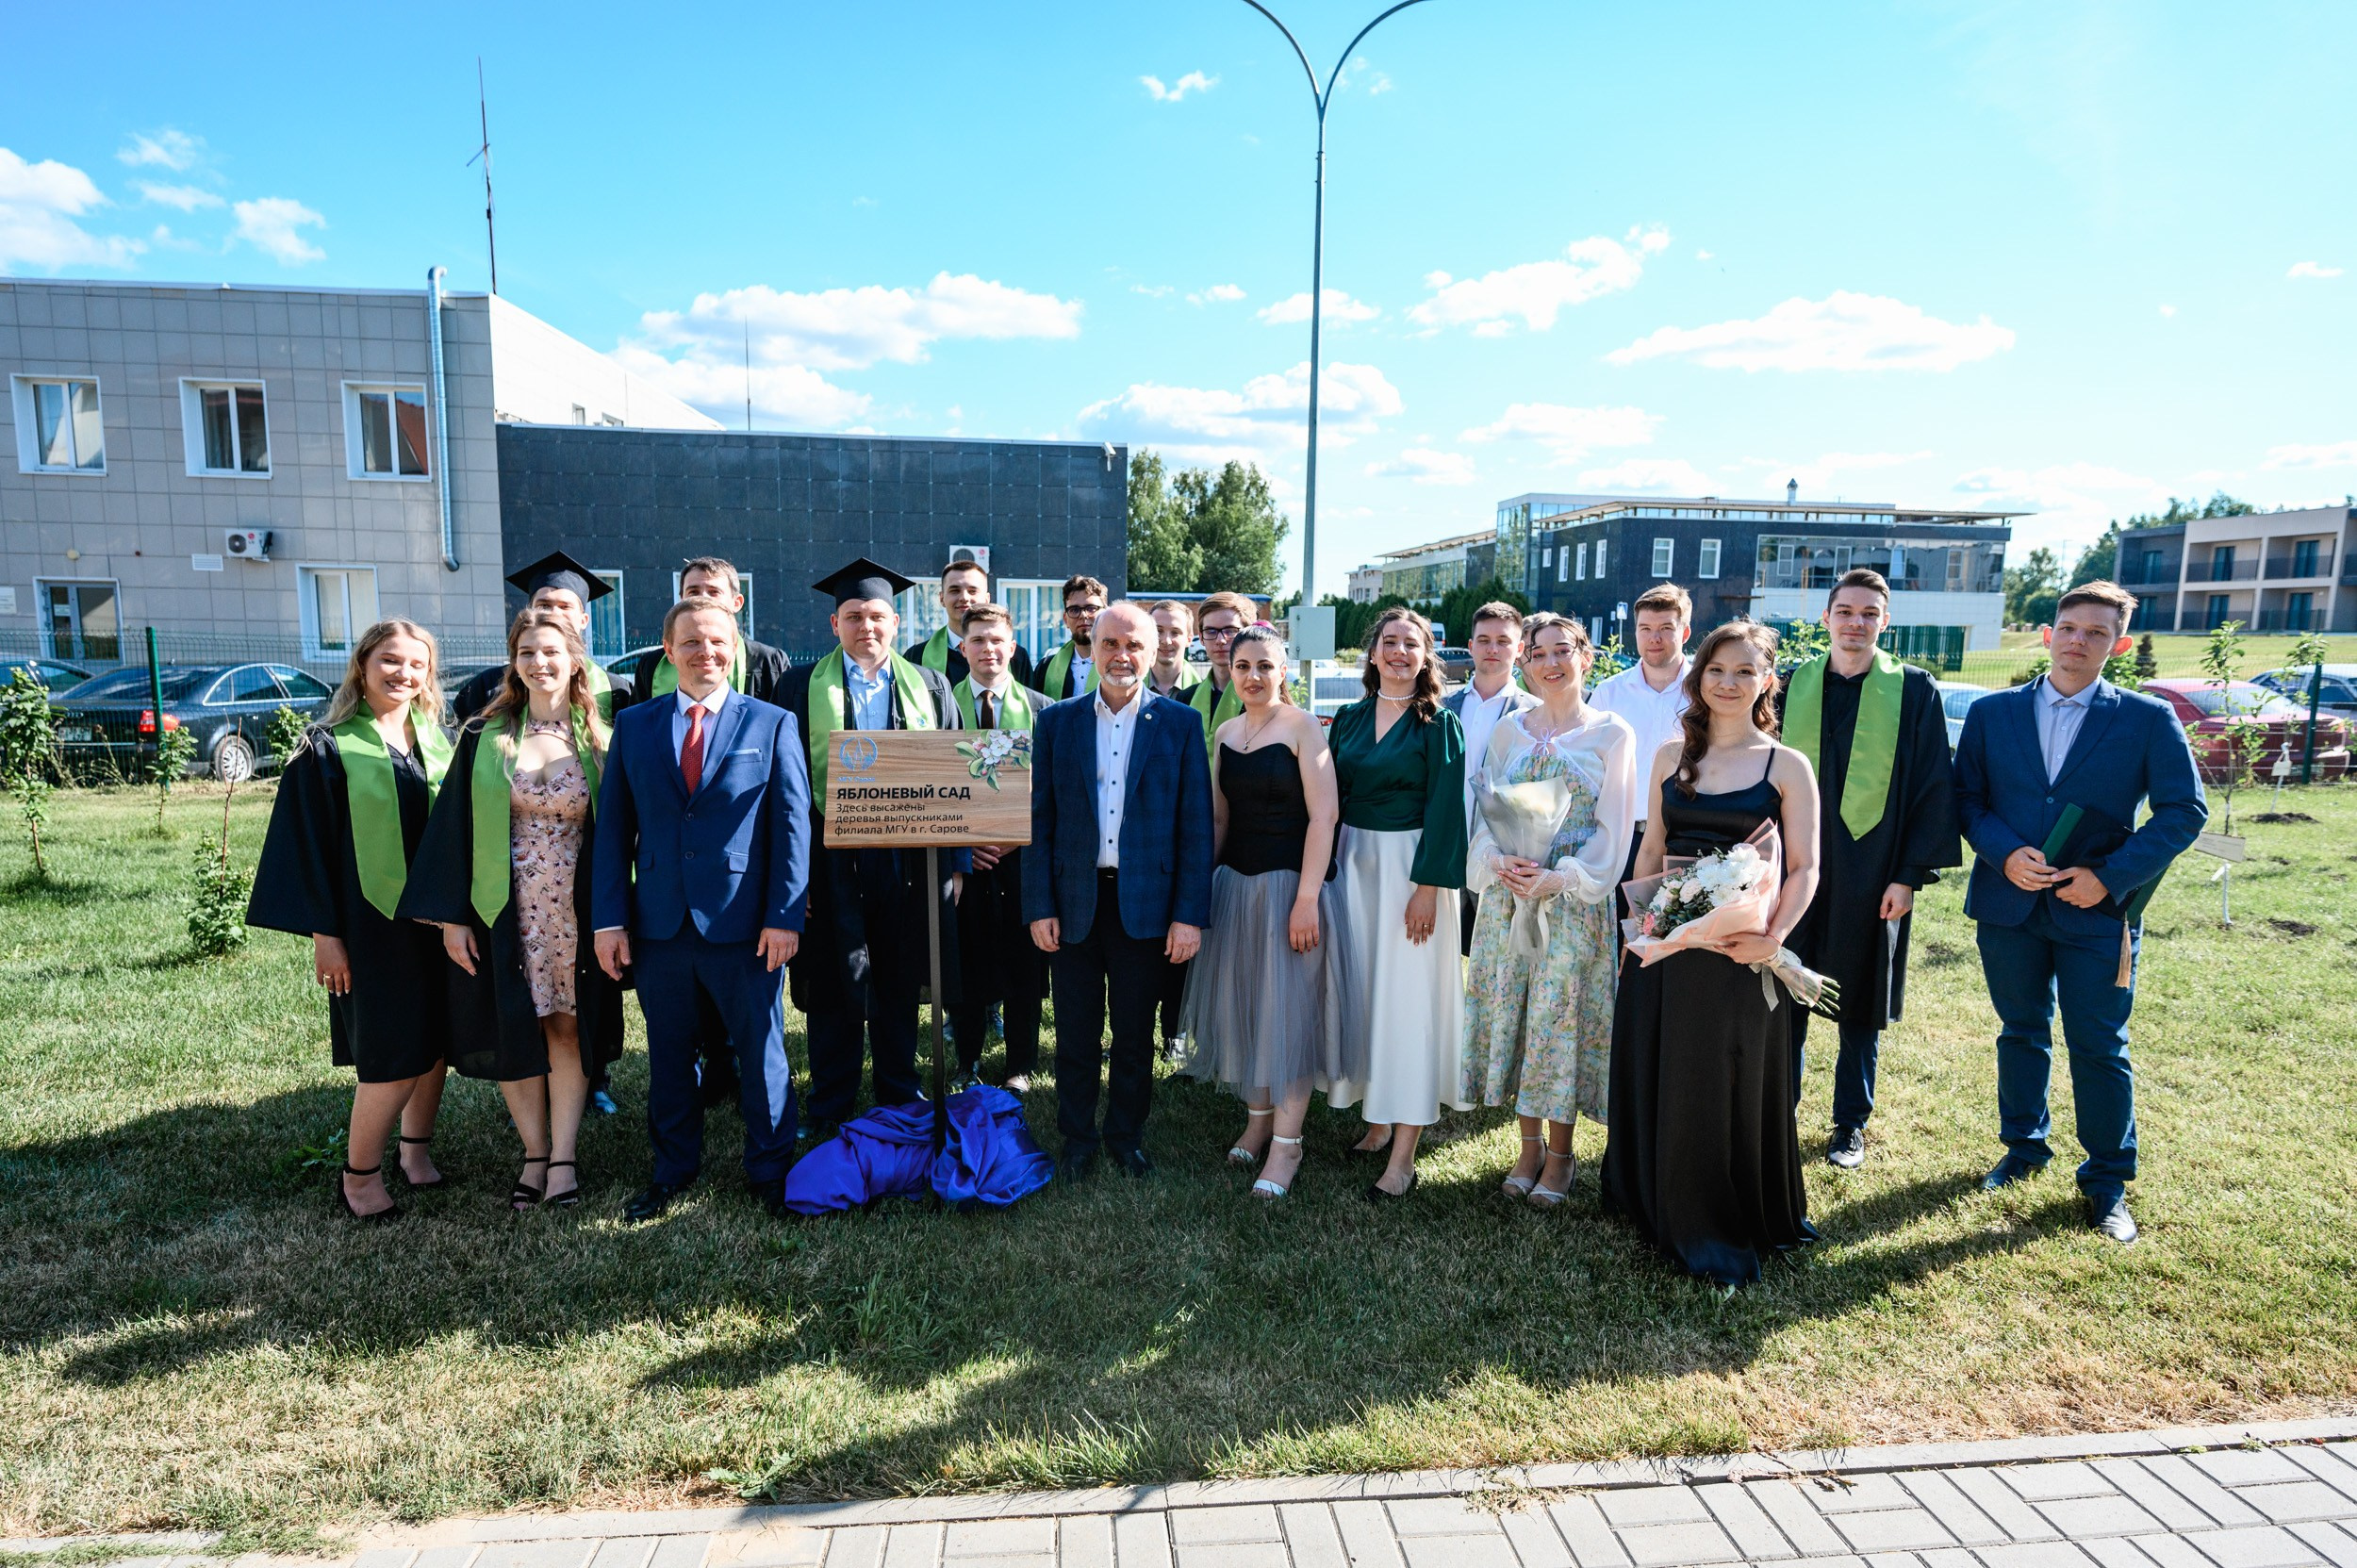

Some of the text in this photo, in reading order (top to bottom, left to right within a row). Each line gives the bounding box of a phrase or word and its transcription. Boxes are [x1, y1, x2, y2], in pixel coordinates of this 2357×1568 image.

[836, 784, 971, 800] ЯБЛОНЕВЫЙ САД
[836, 803, 925, 814] Здесь высажены
[835, 814, 963, 824] деревья выпускниками
[834, 825, 882, 836] филиала
[885, 825, 908, 834] МГУ
[930, 824, 969, 834] Сарове
